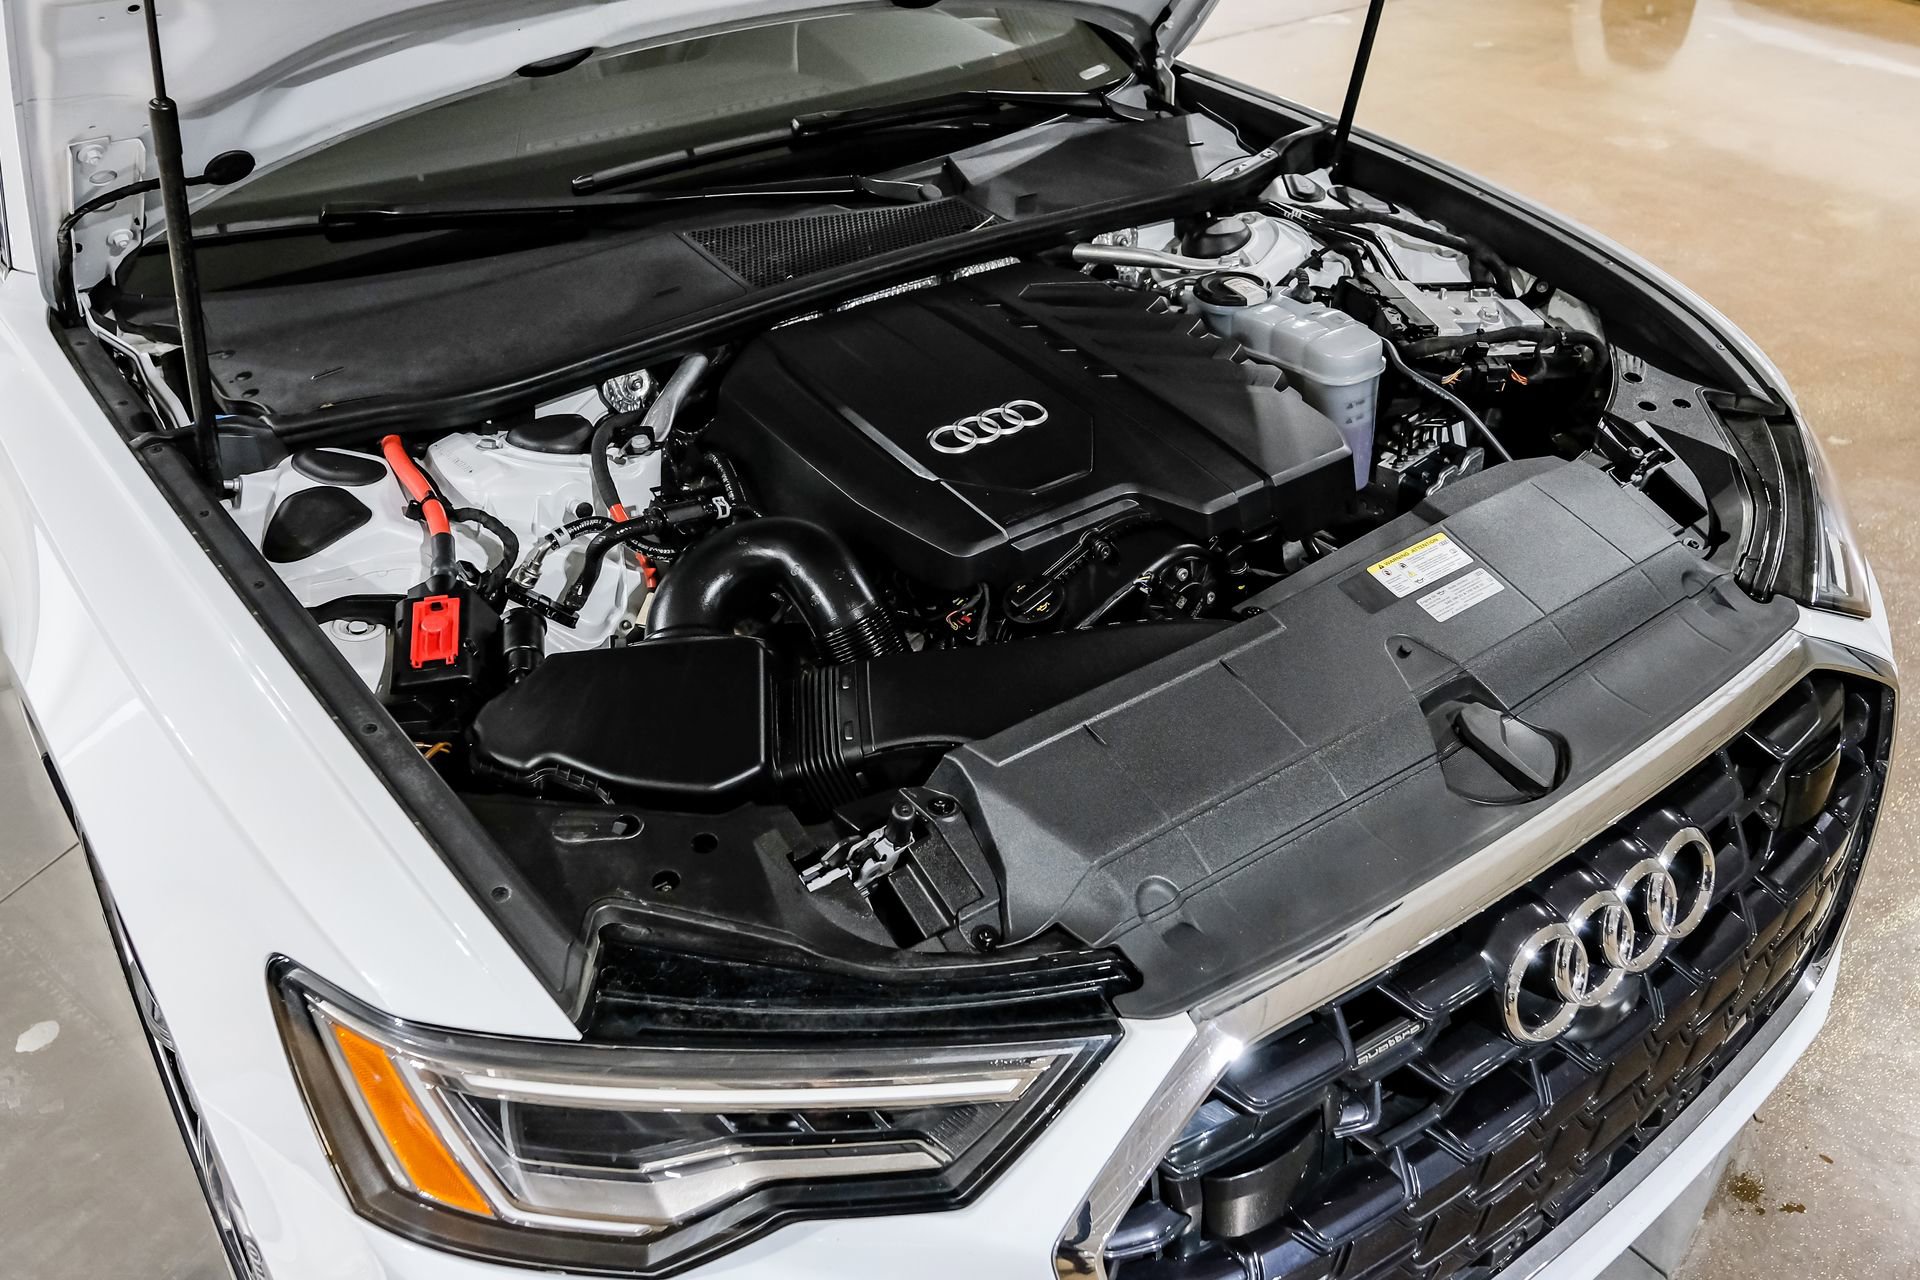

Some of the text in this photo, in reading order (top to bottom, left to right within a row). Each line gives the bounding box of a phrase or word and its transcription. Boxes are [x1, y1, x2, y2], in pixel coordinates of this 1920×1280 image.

[1384, 552, 1410, 566] WARNING
[1411, 538, 1438, 552] ATTENTION
[1357, 1024, 1420, 1066] quattro
